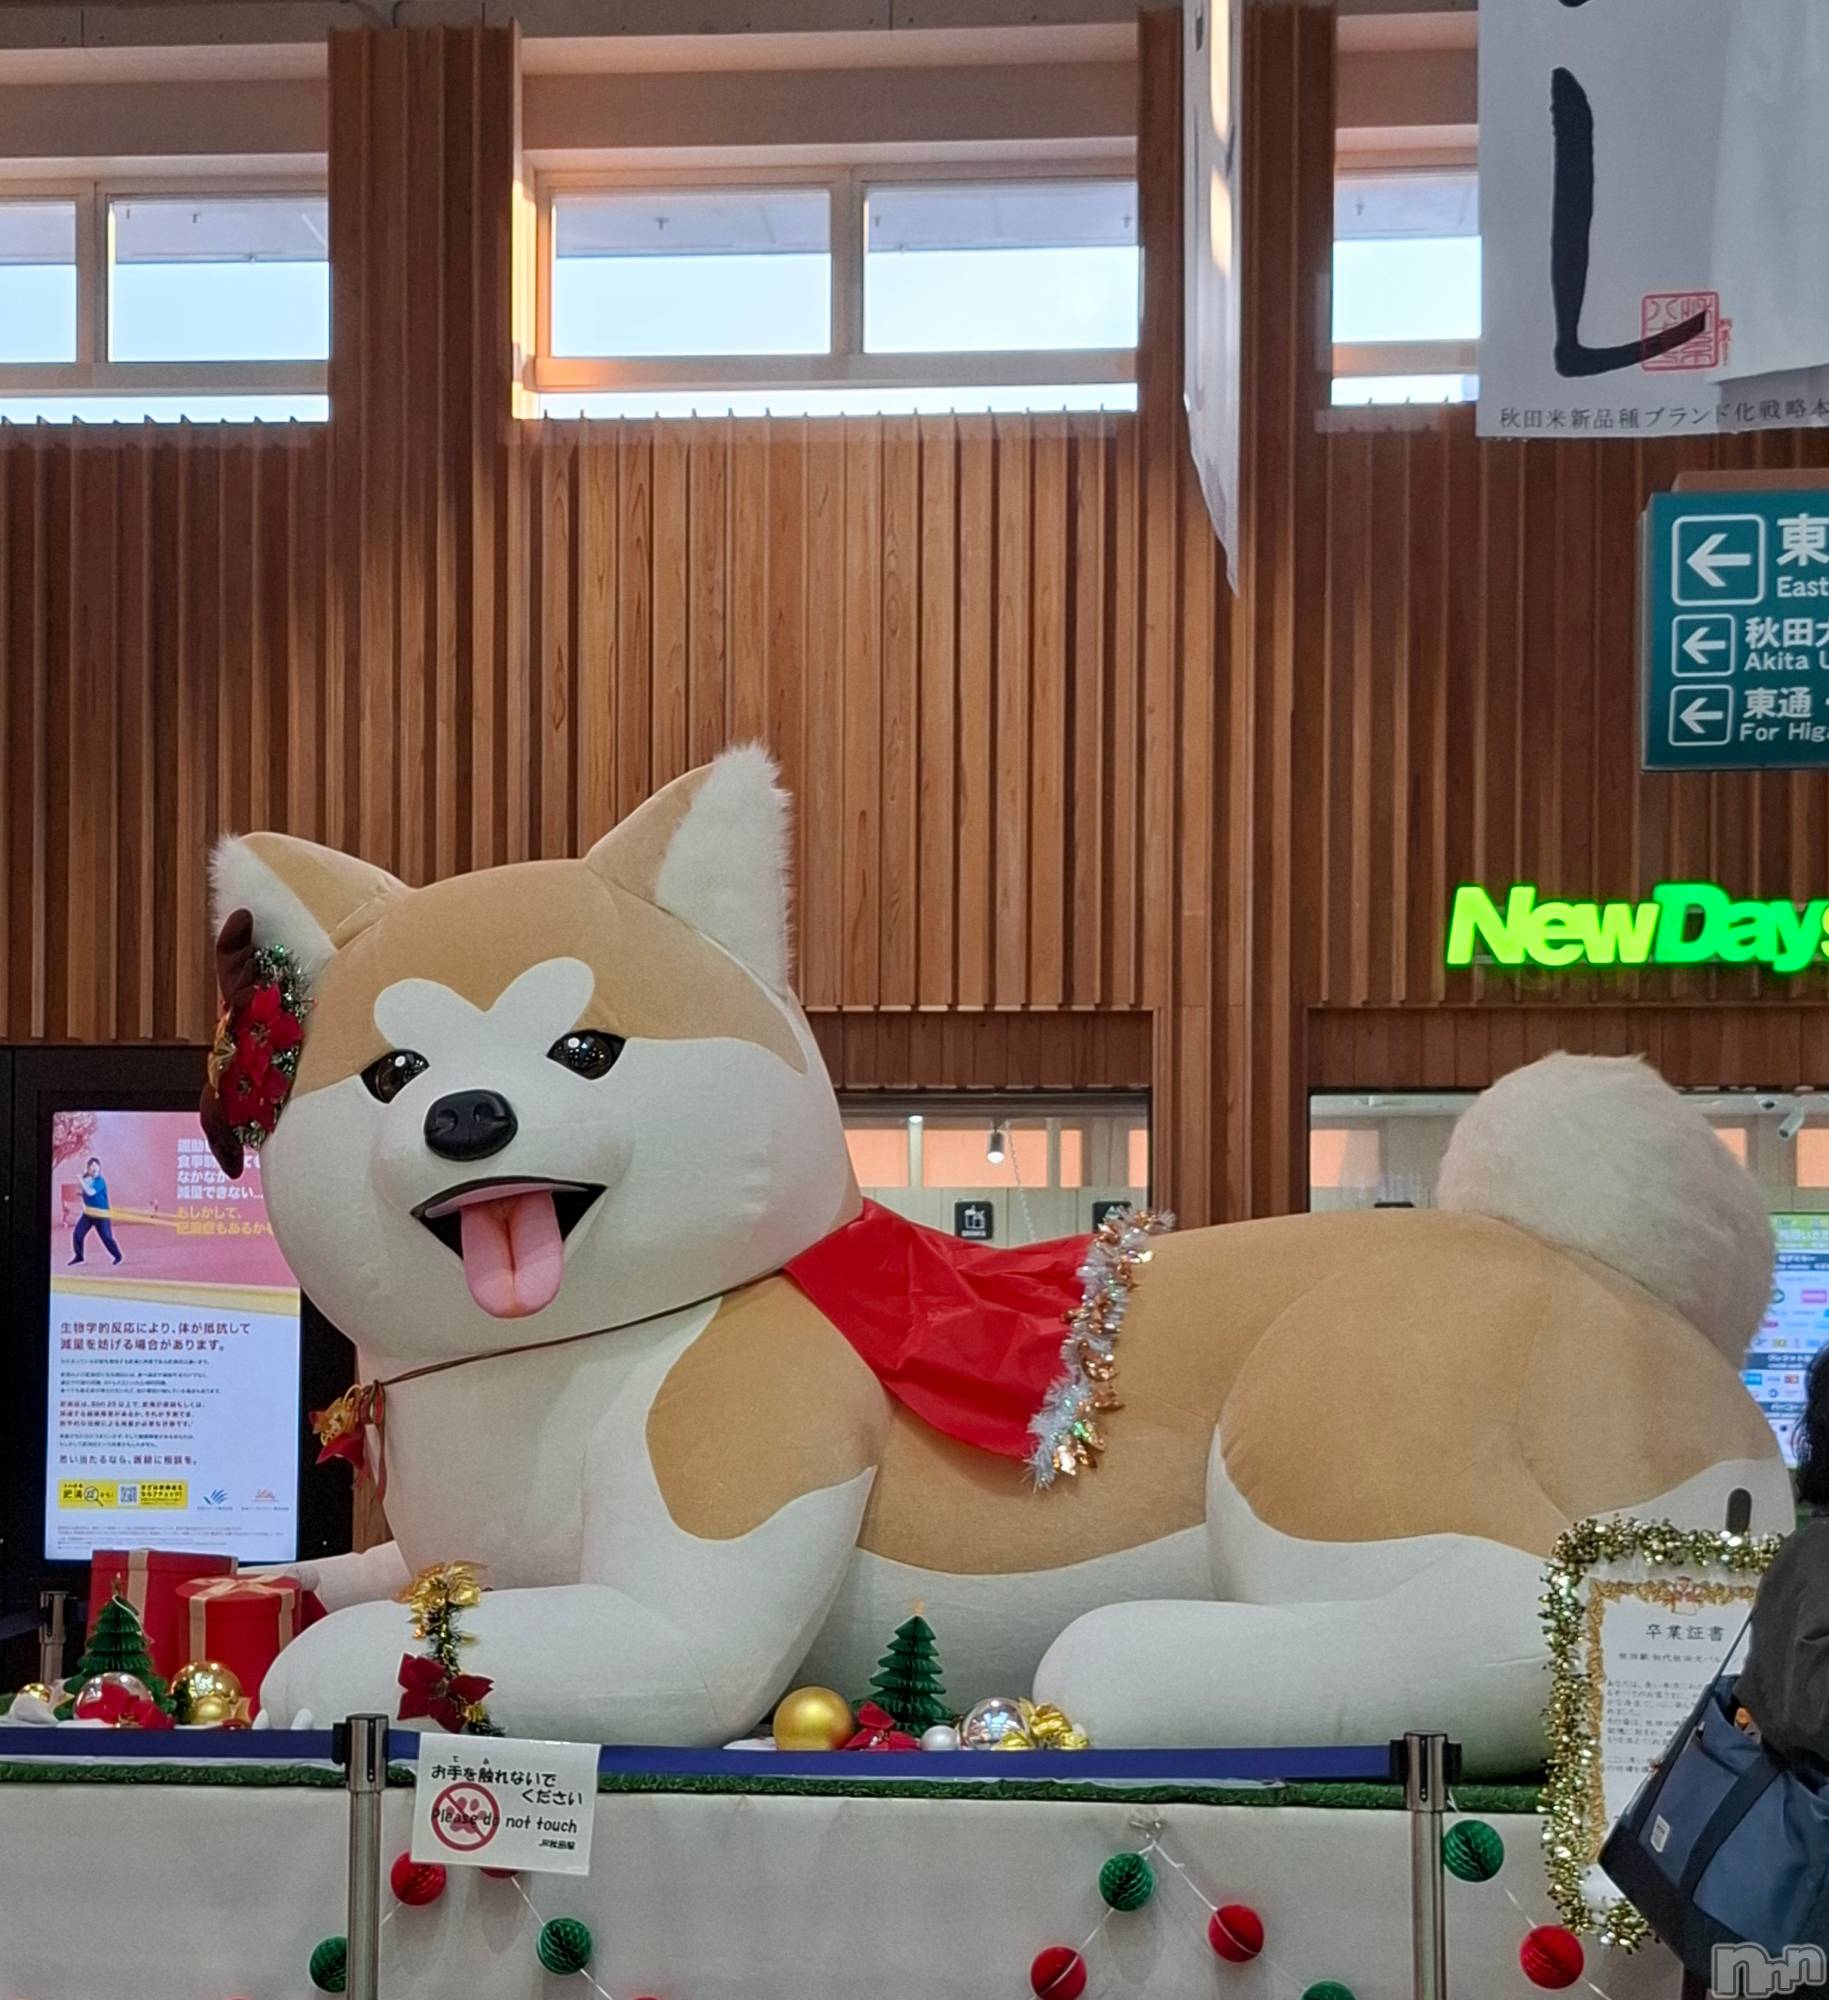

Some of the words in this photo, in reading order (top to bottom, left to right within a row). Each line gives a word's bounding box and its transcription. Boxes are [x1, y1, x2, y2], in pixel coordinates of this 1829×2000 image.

[1777, 513, 1829, 567] 東
[1777, 576, 1829, 598] East
[1744, 652, 1809, 671] Akita
[1739, 723, 1780, 742] For
[1788, 722, 1829, 743] Hig
[1646, 1624, 1724, 1642] 卒業証書
[431, 1764, 557, 1788] お手を触れないで
[521, 1788, 583, 1806] ください
[432, 1807, 478, 1826] Please
[483, 1812, 499, 1826] do
[506, 1815, 532, 1830] not
[536, 1816, 578, 1834] touch
